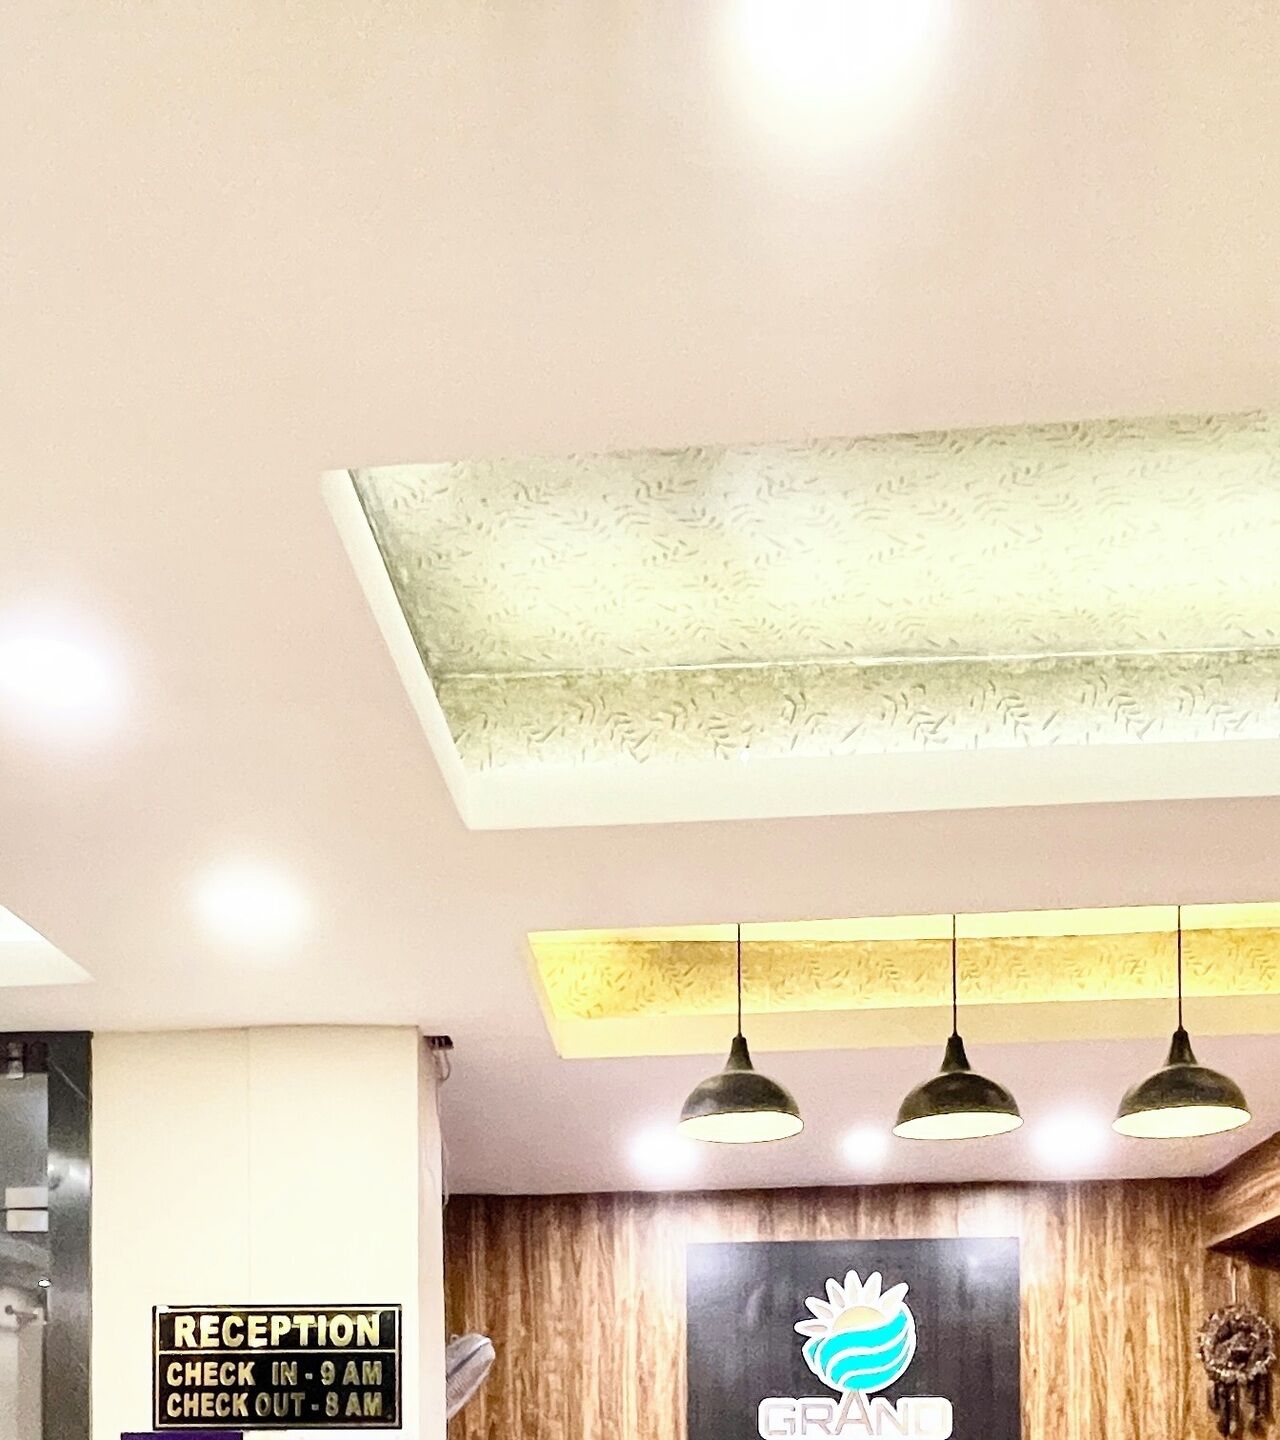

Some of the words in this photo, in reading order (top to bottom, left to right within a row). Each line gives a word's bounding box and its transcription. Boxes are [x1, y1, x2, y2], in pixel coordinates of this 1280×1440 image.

[173, 1314, 381, 1348] RECEPTION
[166, 1361, 256, 1387] CHECK
[272, 1361, 298, 1387] IN
[320, 1361, 336, 1387] 9
[343, 1361, 383, 1387] AM
[166, 1392, 249, 1418] CHECK
[254, 1392, 306, 1418] OUT
[343, 1392, 383, 1418] AM
[763, 1390, 948, 1437] GRAND
